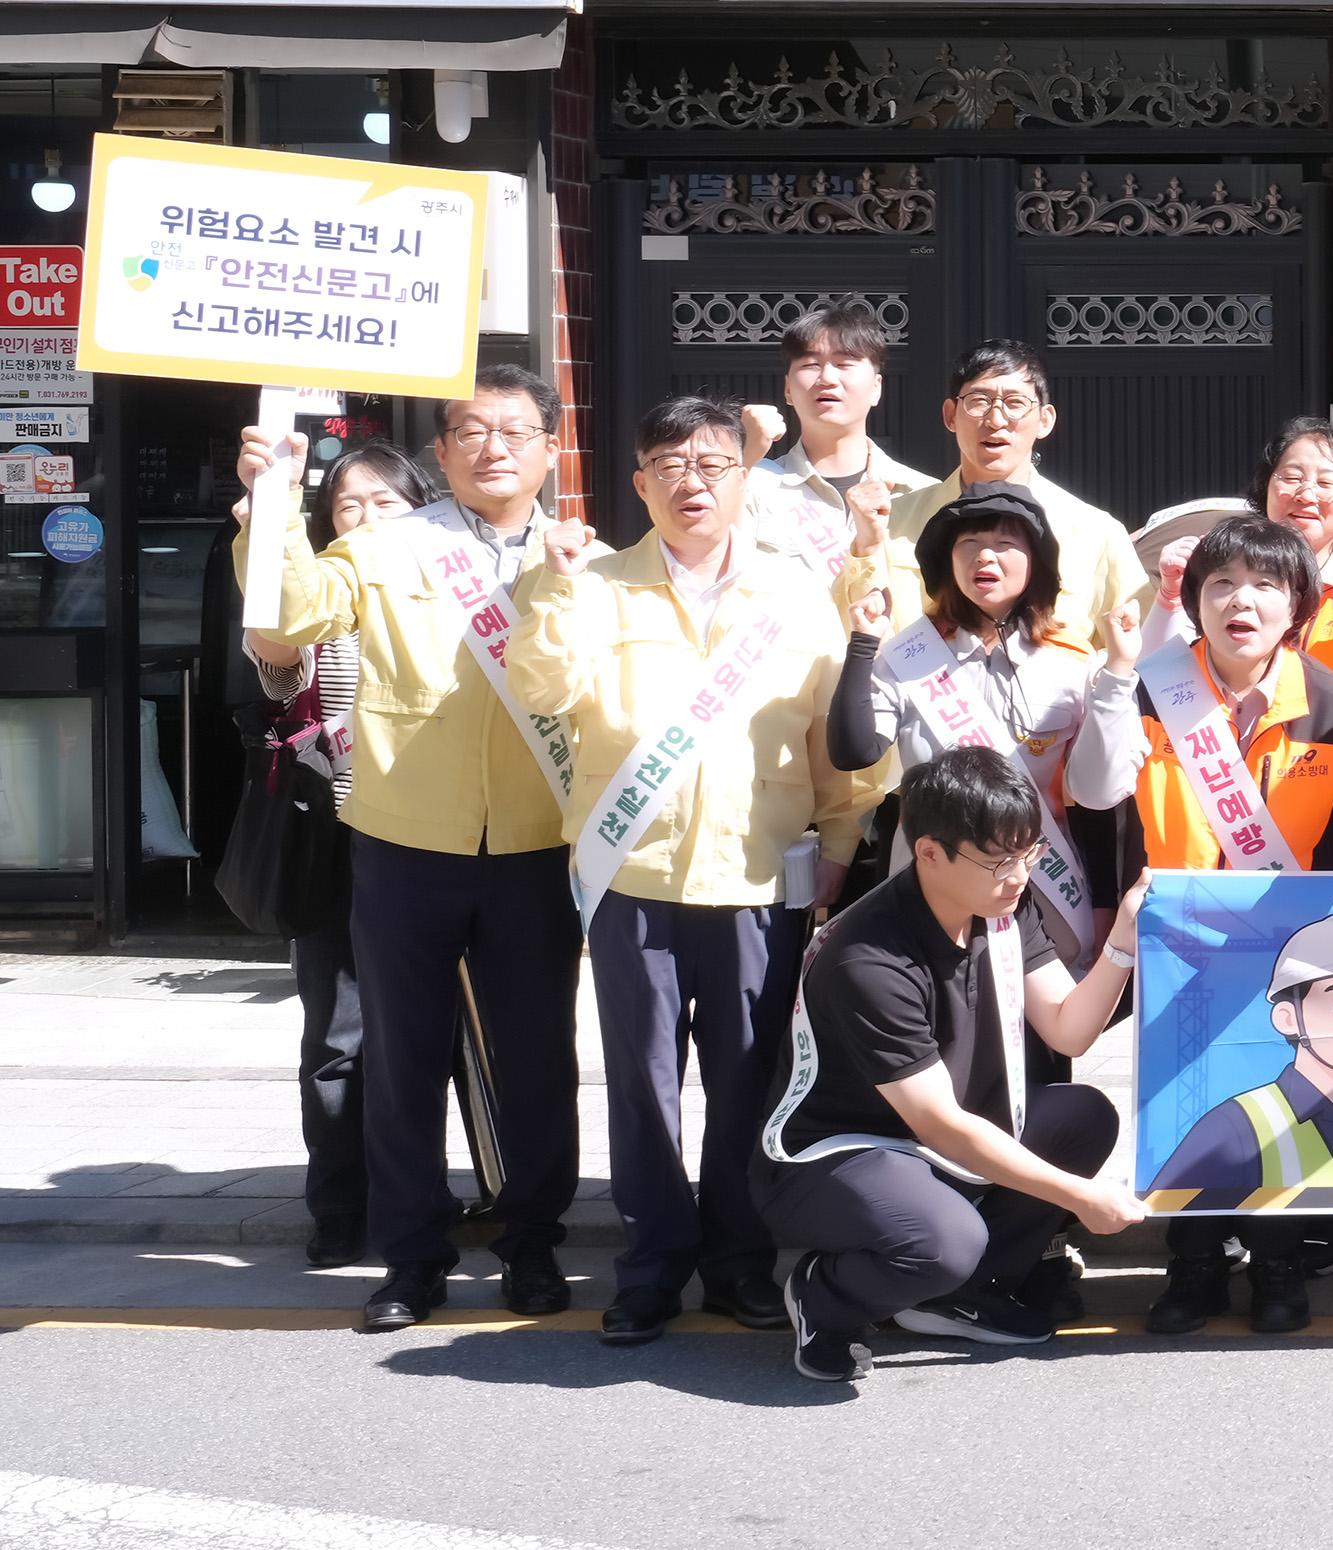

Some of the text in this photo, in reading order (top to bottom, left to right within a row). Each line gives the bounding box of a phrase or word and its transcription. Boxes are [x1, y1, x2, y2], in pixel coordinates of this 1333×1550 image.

[421, 201, 463, 216] 광주시
[160, 205, 421, 257] 위험요소 발견 시
[151, 240, 182, 257] 안전
[0, 257, 78, 284] Take
[205, 255, 439, 304] 『안전신문고』에
[7, 290, 65, 316] Out
[172, 301, 397, 347] 신고해주세요!
[31, 337, 57, 354] 설치
[60, 337, 77, 354] 점
[66, 359, 76, 371] 운
[15, 423, 62, 437] 판매금지
[57, 521, 89, 533] 고유가
[920, 670, 996, 750] 재난예
[597, 612, 782, 848] 재난예방 안전실천
[1276, 764, 1329, 779] 의용소방대
[1184, 725, 1267, 856] 재난예방
